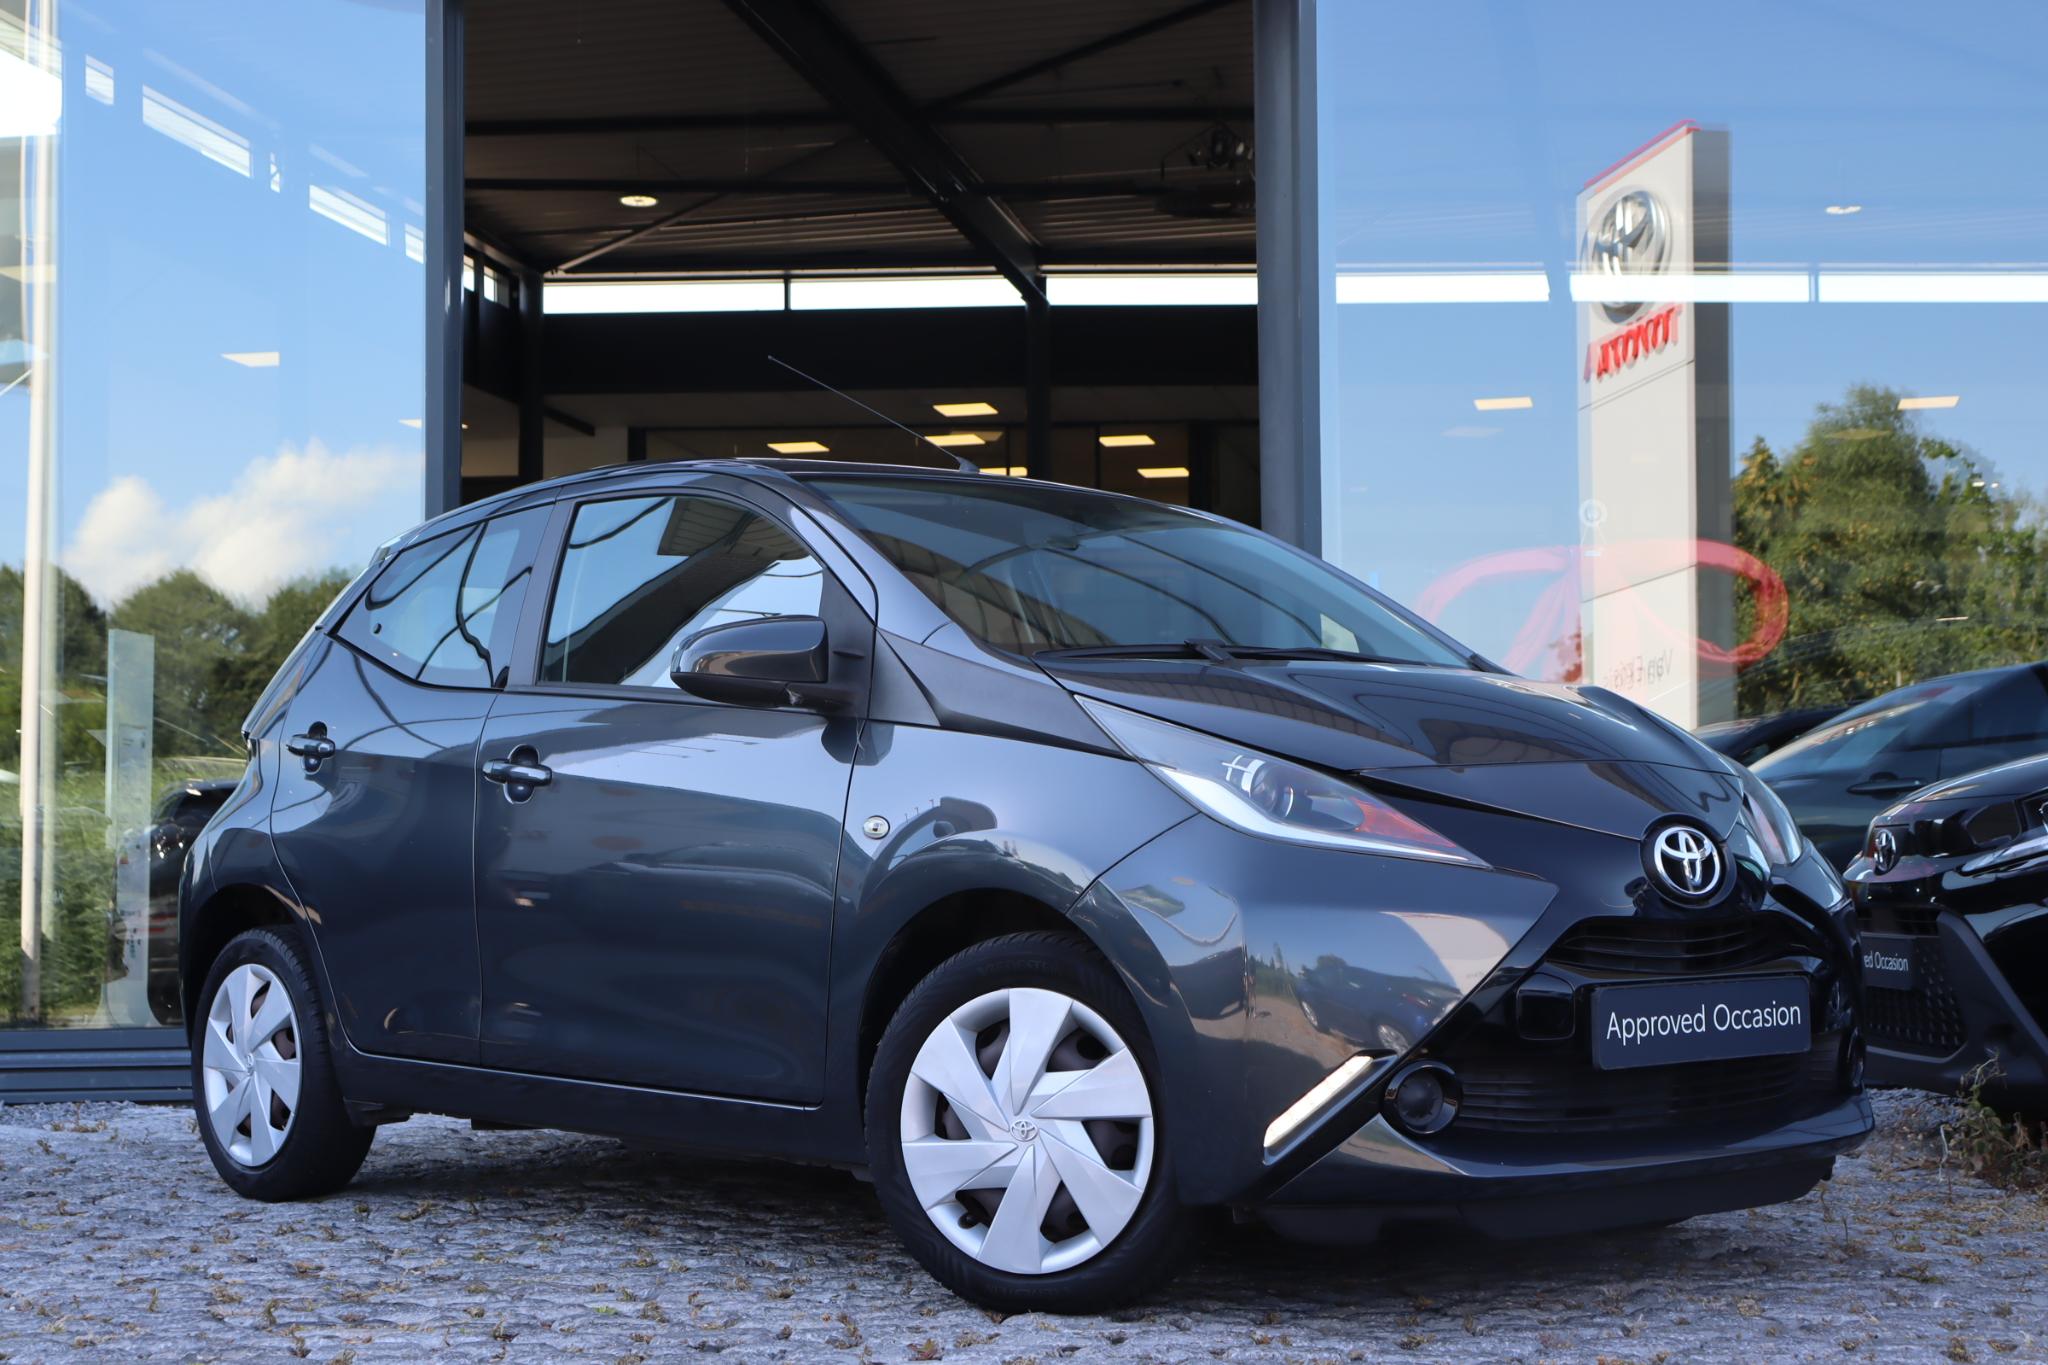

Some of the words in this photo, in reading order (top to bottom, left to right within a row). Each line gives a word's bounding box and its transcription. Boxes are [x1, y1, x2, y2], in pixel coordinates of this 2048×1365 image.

[1874, 951, 1909, 971] Occasion
[1606, 1004, 1706, 1046] Approved
[1713, 1000, 1801, 1031] Occasion
